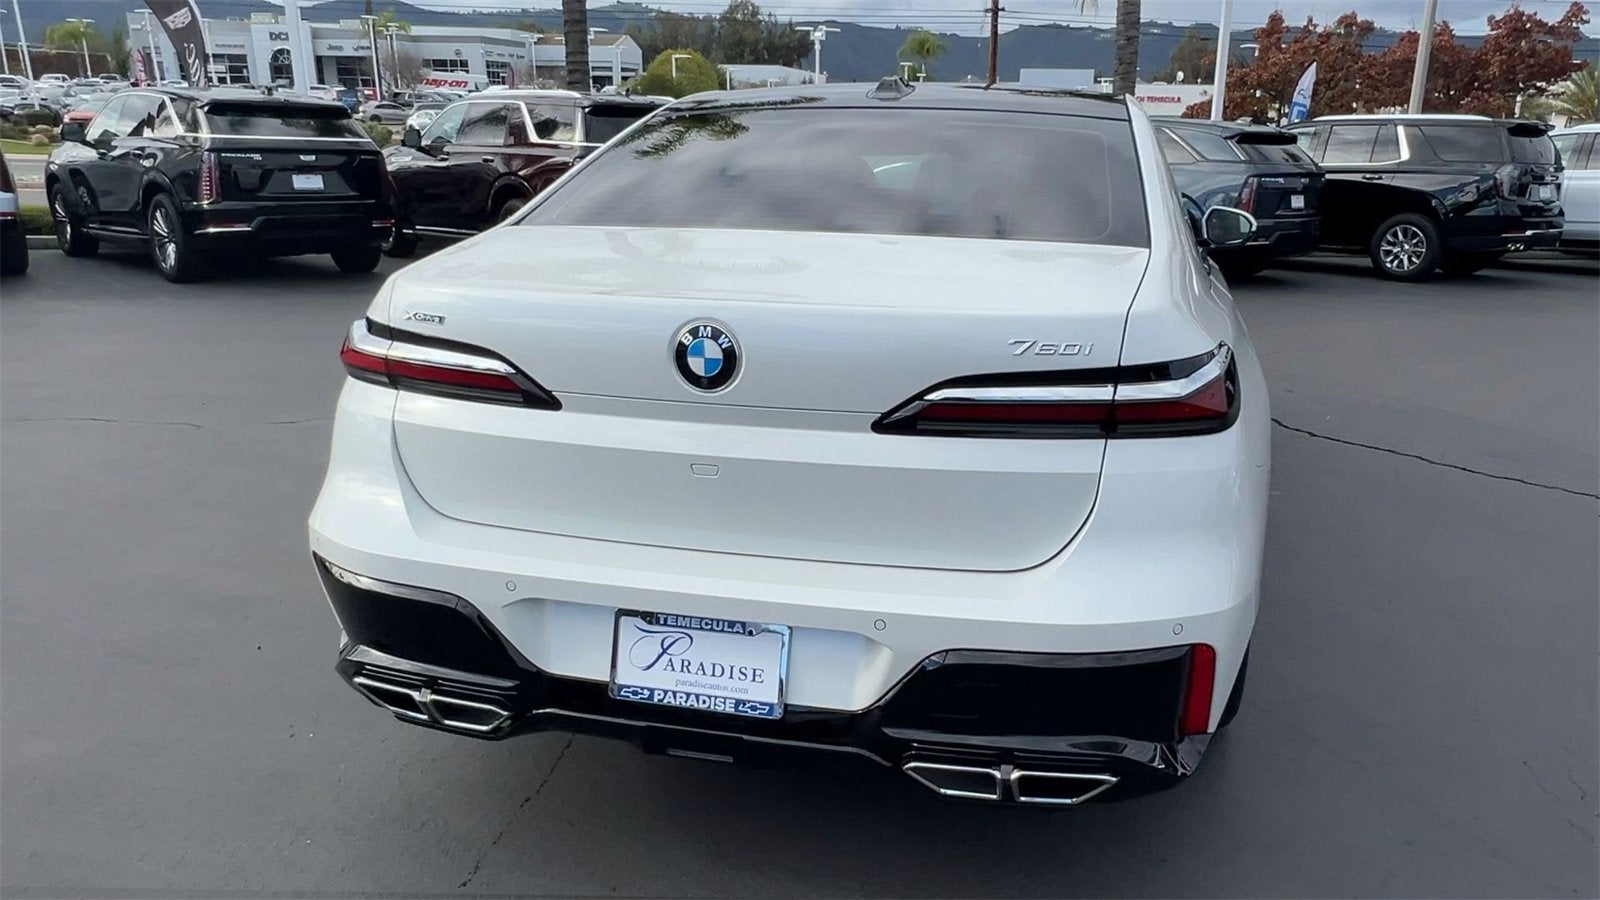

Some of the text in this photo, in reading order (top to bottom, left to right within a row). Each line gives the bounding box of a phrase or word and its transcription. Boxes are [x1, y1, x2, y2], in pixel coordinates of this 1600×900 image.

[681, 325, 732, 349] BMW
[1007, 338, 1095, 356] 760i
[656, 613, 744, 634] TEMECULA
[675, 679, 749, 695] paradiseautos.com
[653, 690, 737, 712] PARADISE
